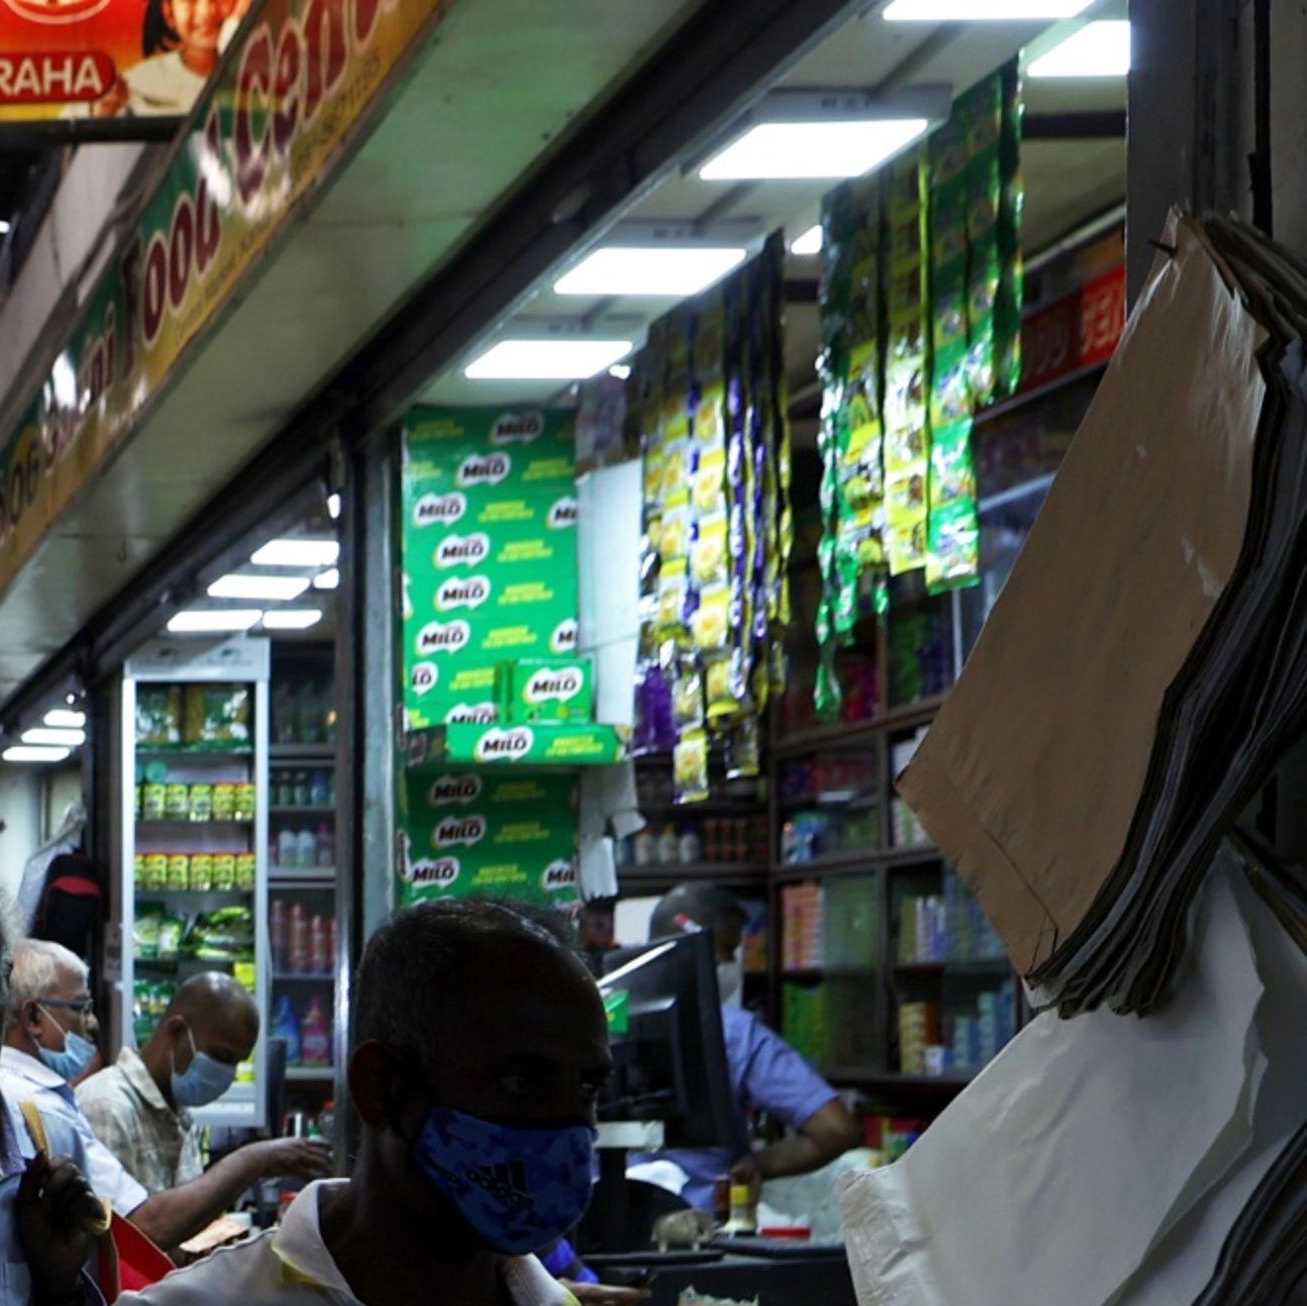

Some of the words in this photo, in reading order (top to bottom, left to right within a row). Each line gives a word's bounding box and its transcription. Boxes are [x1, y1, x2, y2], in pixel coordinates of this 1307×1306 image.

[463, 459, 505, 479] MILO
[418, 499, 461, 519] MILO
[555, 505, 577, 521] MI
[441, 540, 484, 560] MILO
[442, 583, 485, 603] MILO
[422, 627, 465, 647] MILO
[531, 676, 577, 696] MILO
[482, 736, 528, 754] MILO
[433, 780, 476, 799] MILO
[438, 822, 481, 841] MILO
[413, 865, 455, 882] MILO
